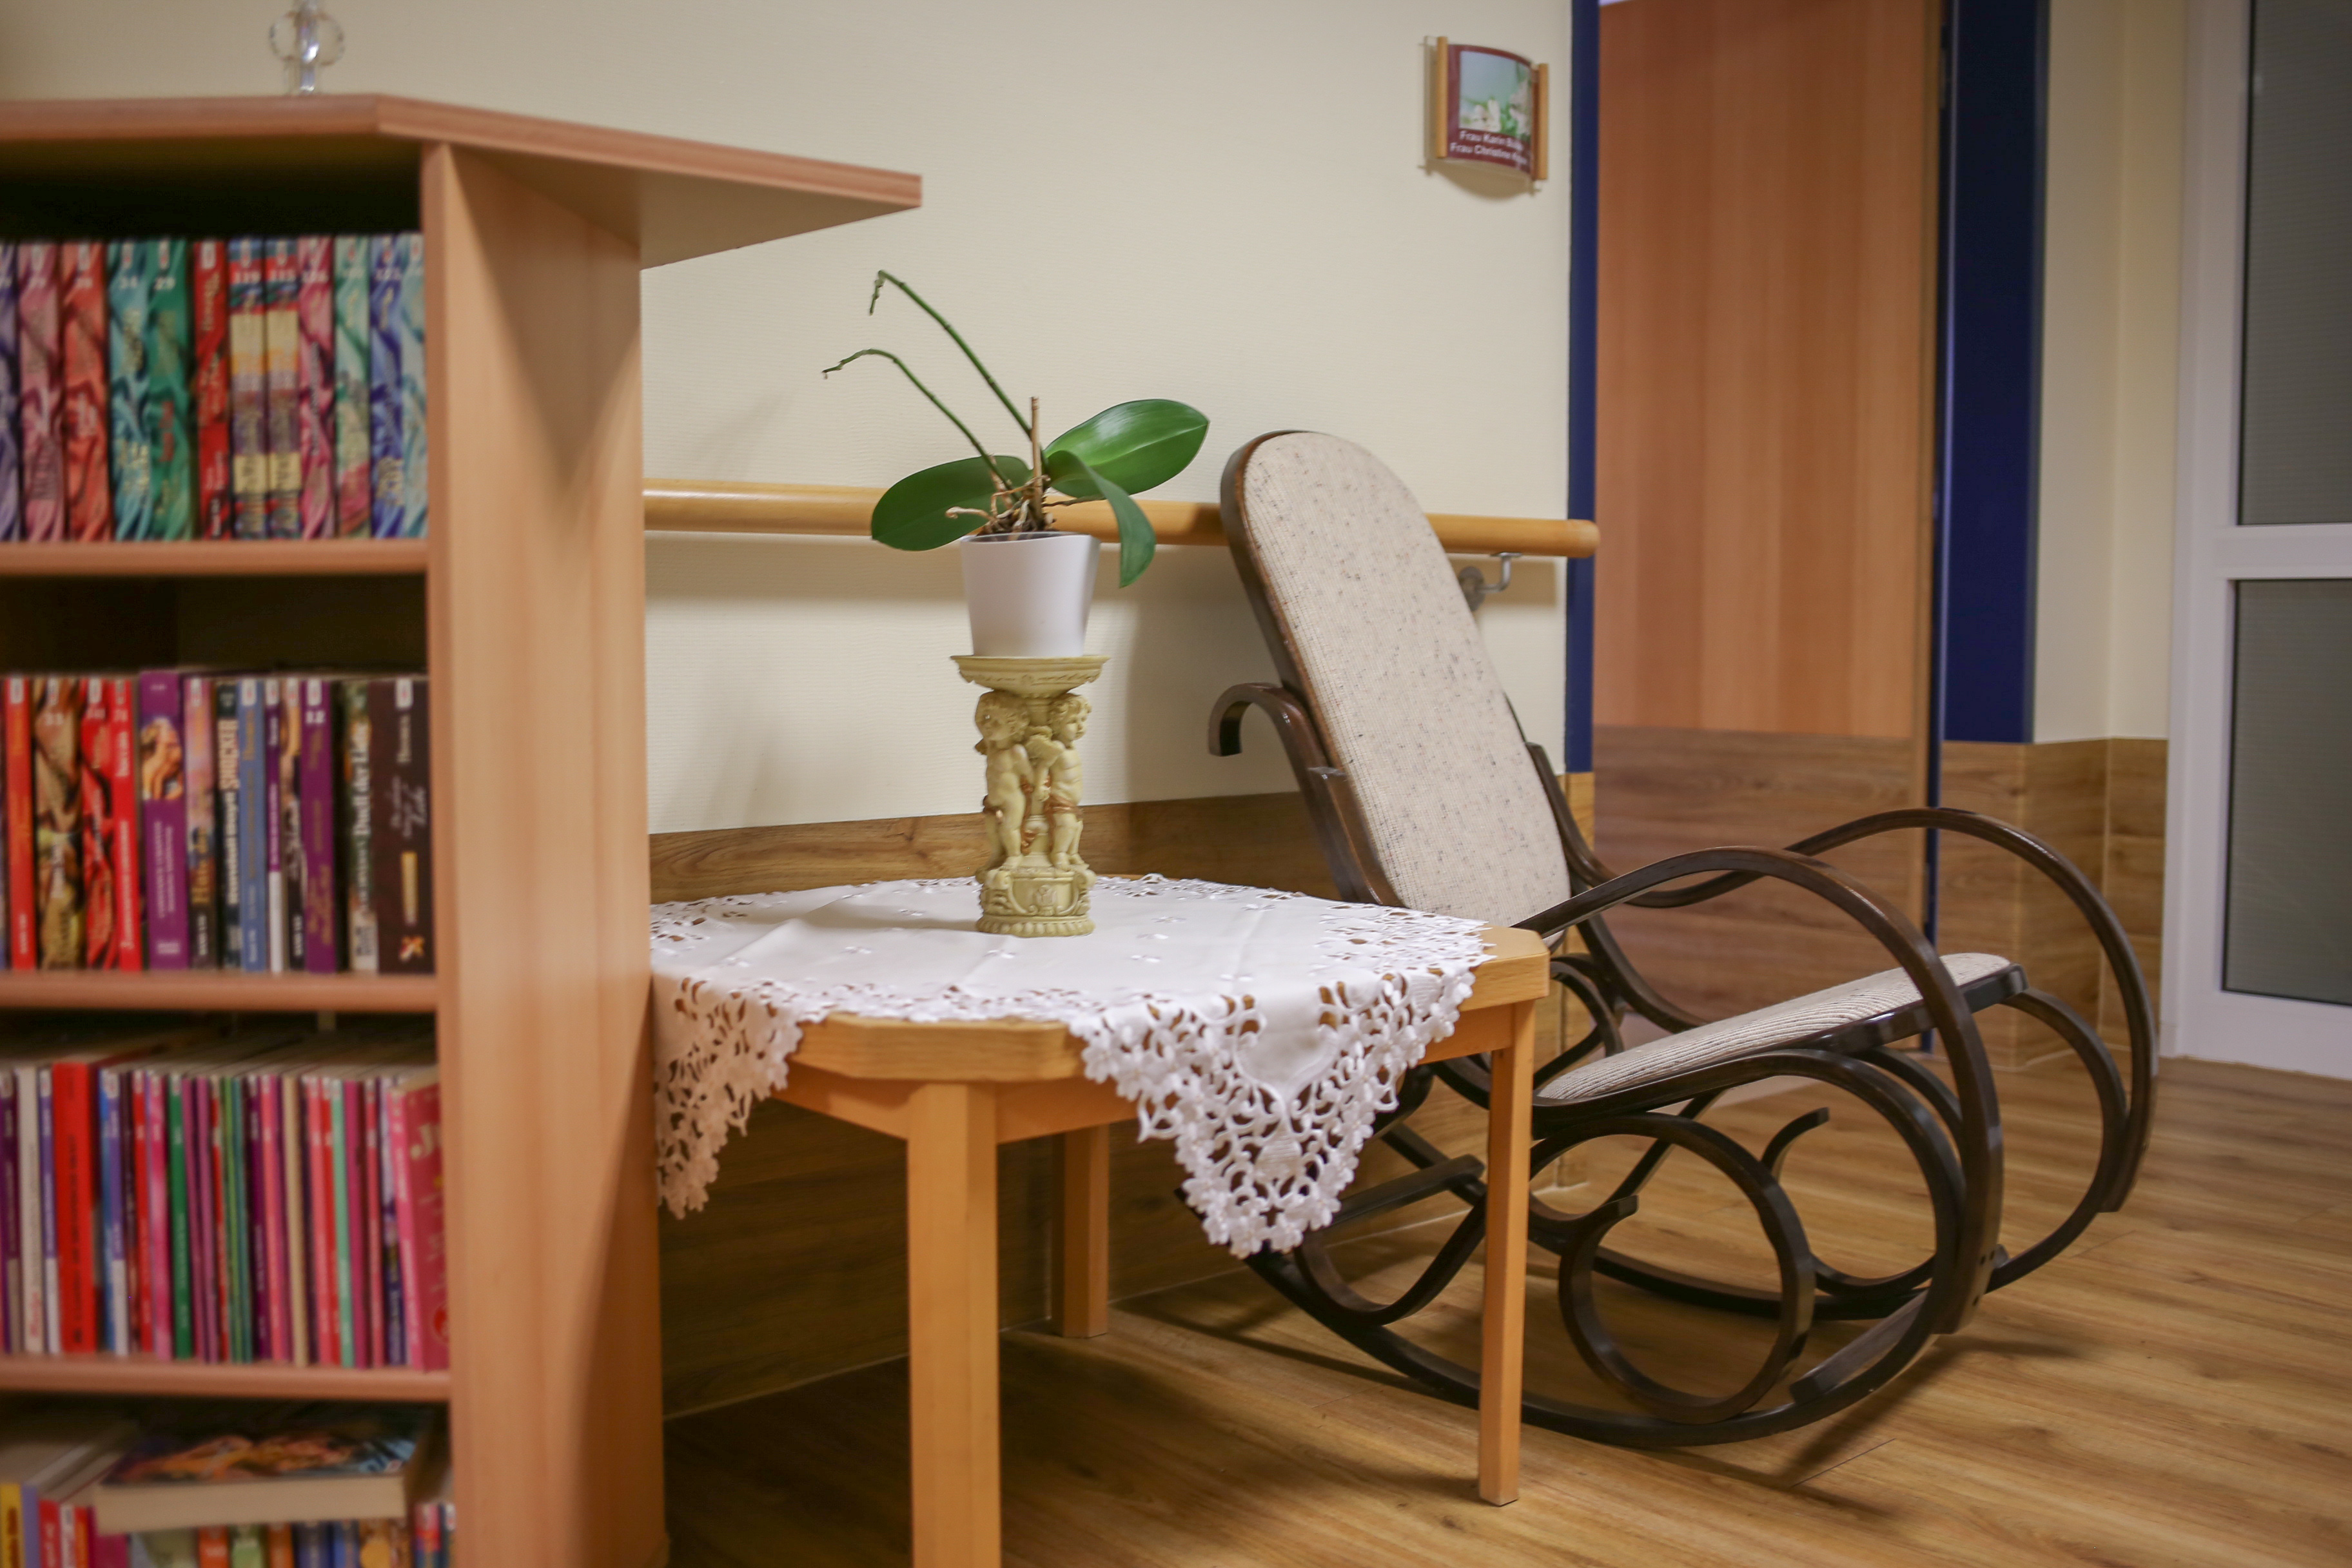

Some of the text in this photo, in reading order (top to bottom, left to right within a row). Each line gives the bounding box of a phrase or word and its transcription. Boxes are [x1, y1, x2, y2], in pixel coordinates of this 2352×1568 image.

[1449, 142, 1473, 153] Frau
[218, 719, 239, 790] SHOCKER
[352, 765, 369, 793] der
